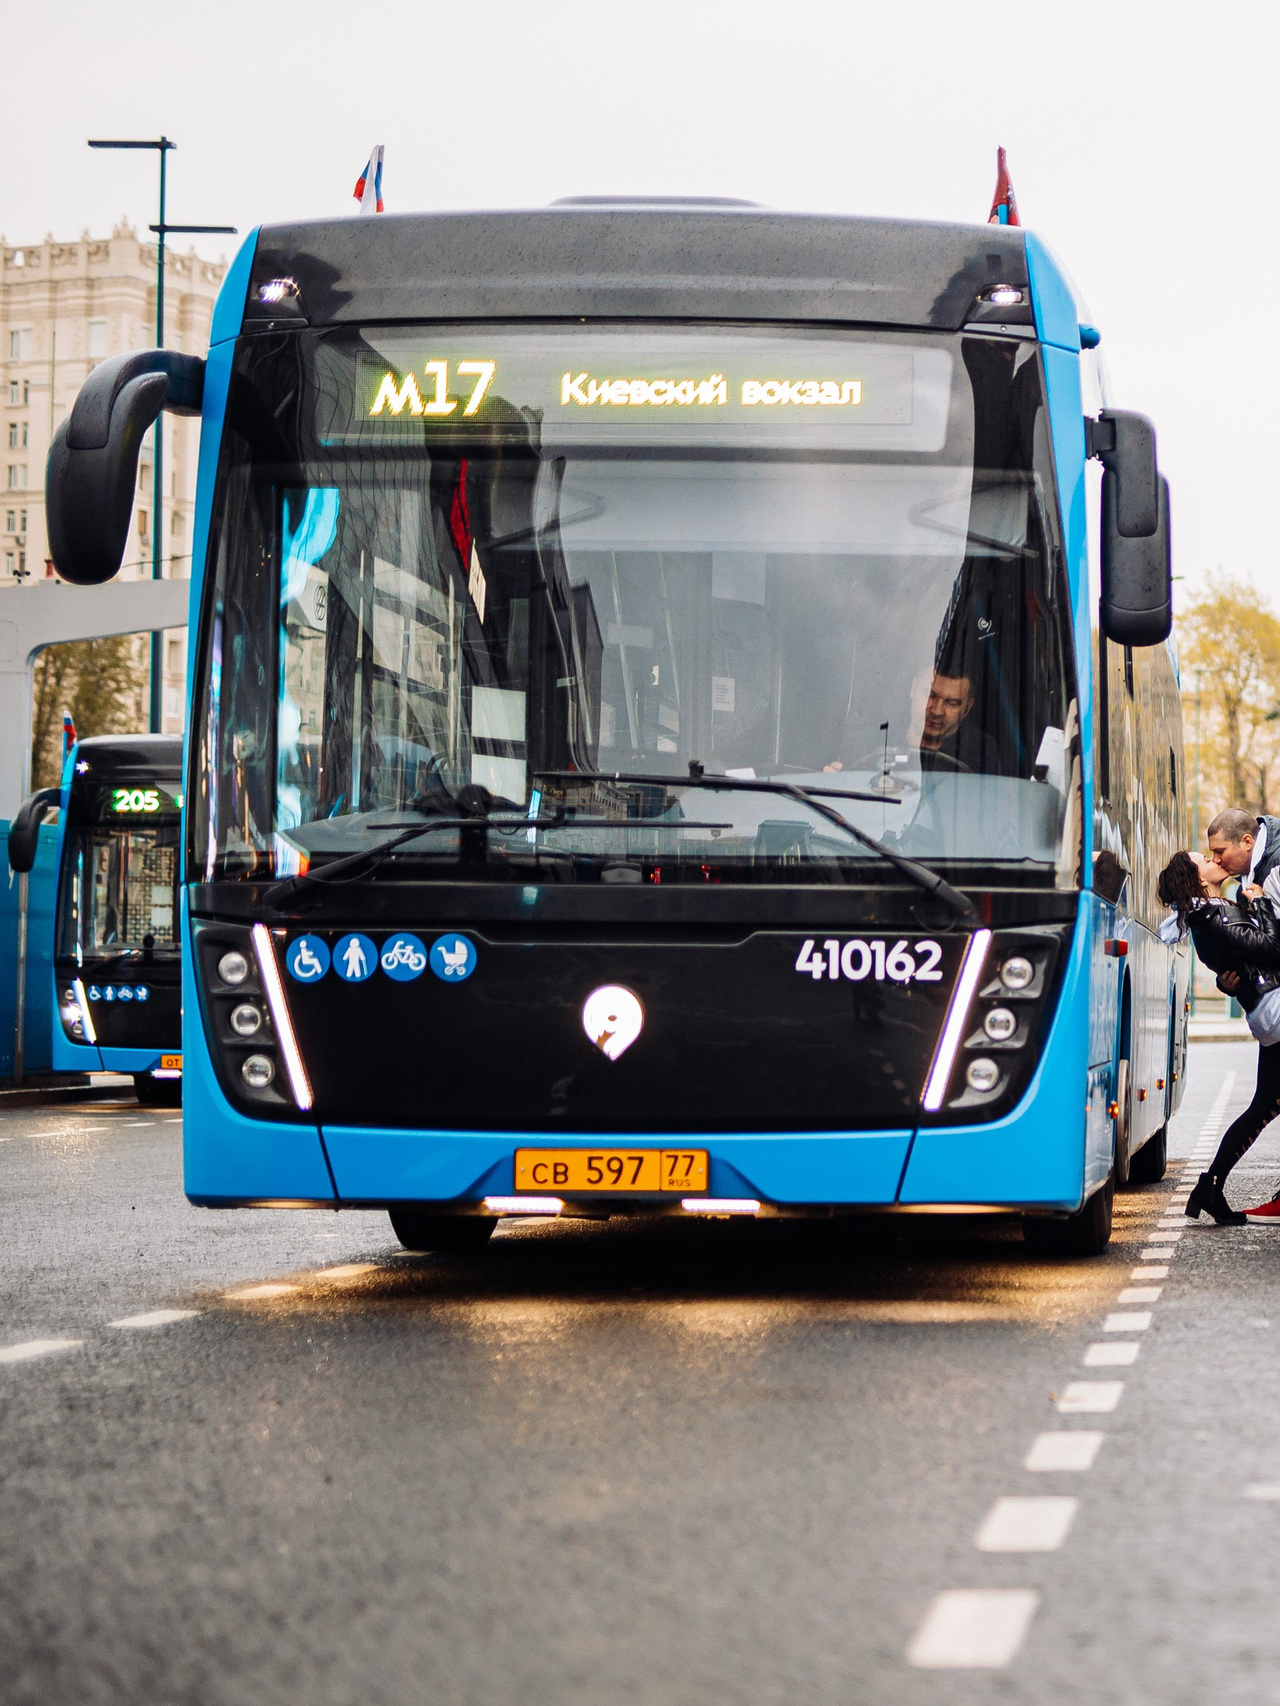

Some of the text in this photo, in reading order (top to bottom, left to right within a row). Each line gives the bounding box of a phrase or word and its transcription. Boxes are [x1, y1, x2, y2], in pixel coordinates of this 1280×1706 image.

[560, 371, 863, 407] Киевский вокзал
[112, 789, 160, 813] 205
[795, 939, 944, 981] 410162
[586, 1156, 644, 1185] 597
[666, 1155, 695, 1177] 77
[668, 1178, 691, 1187] RUS
